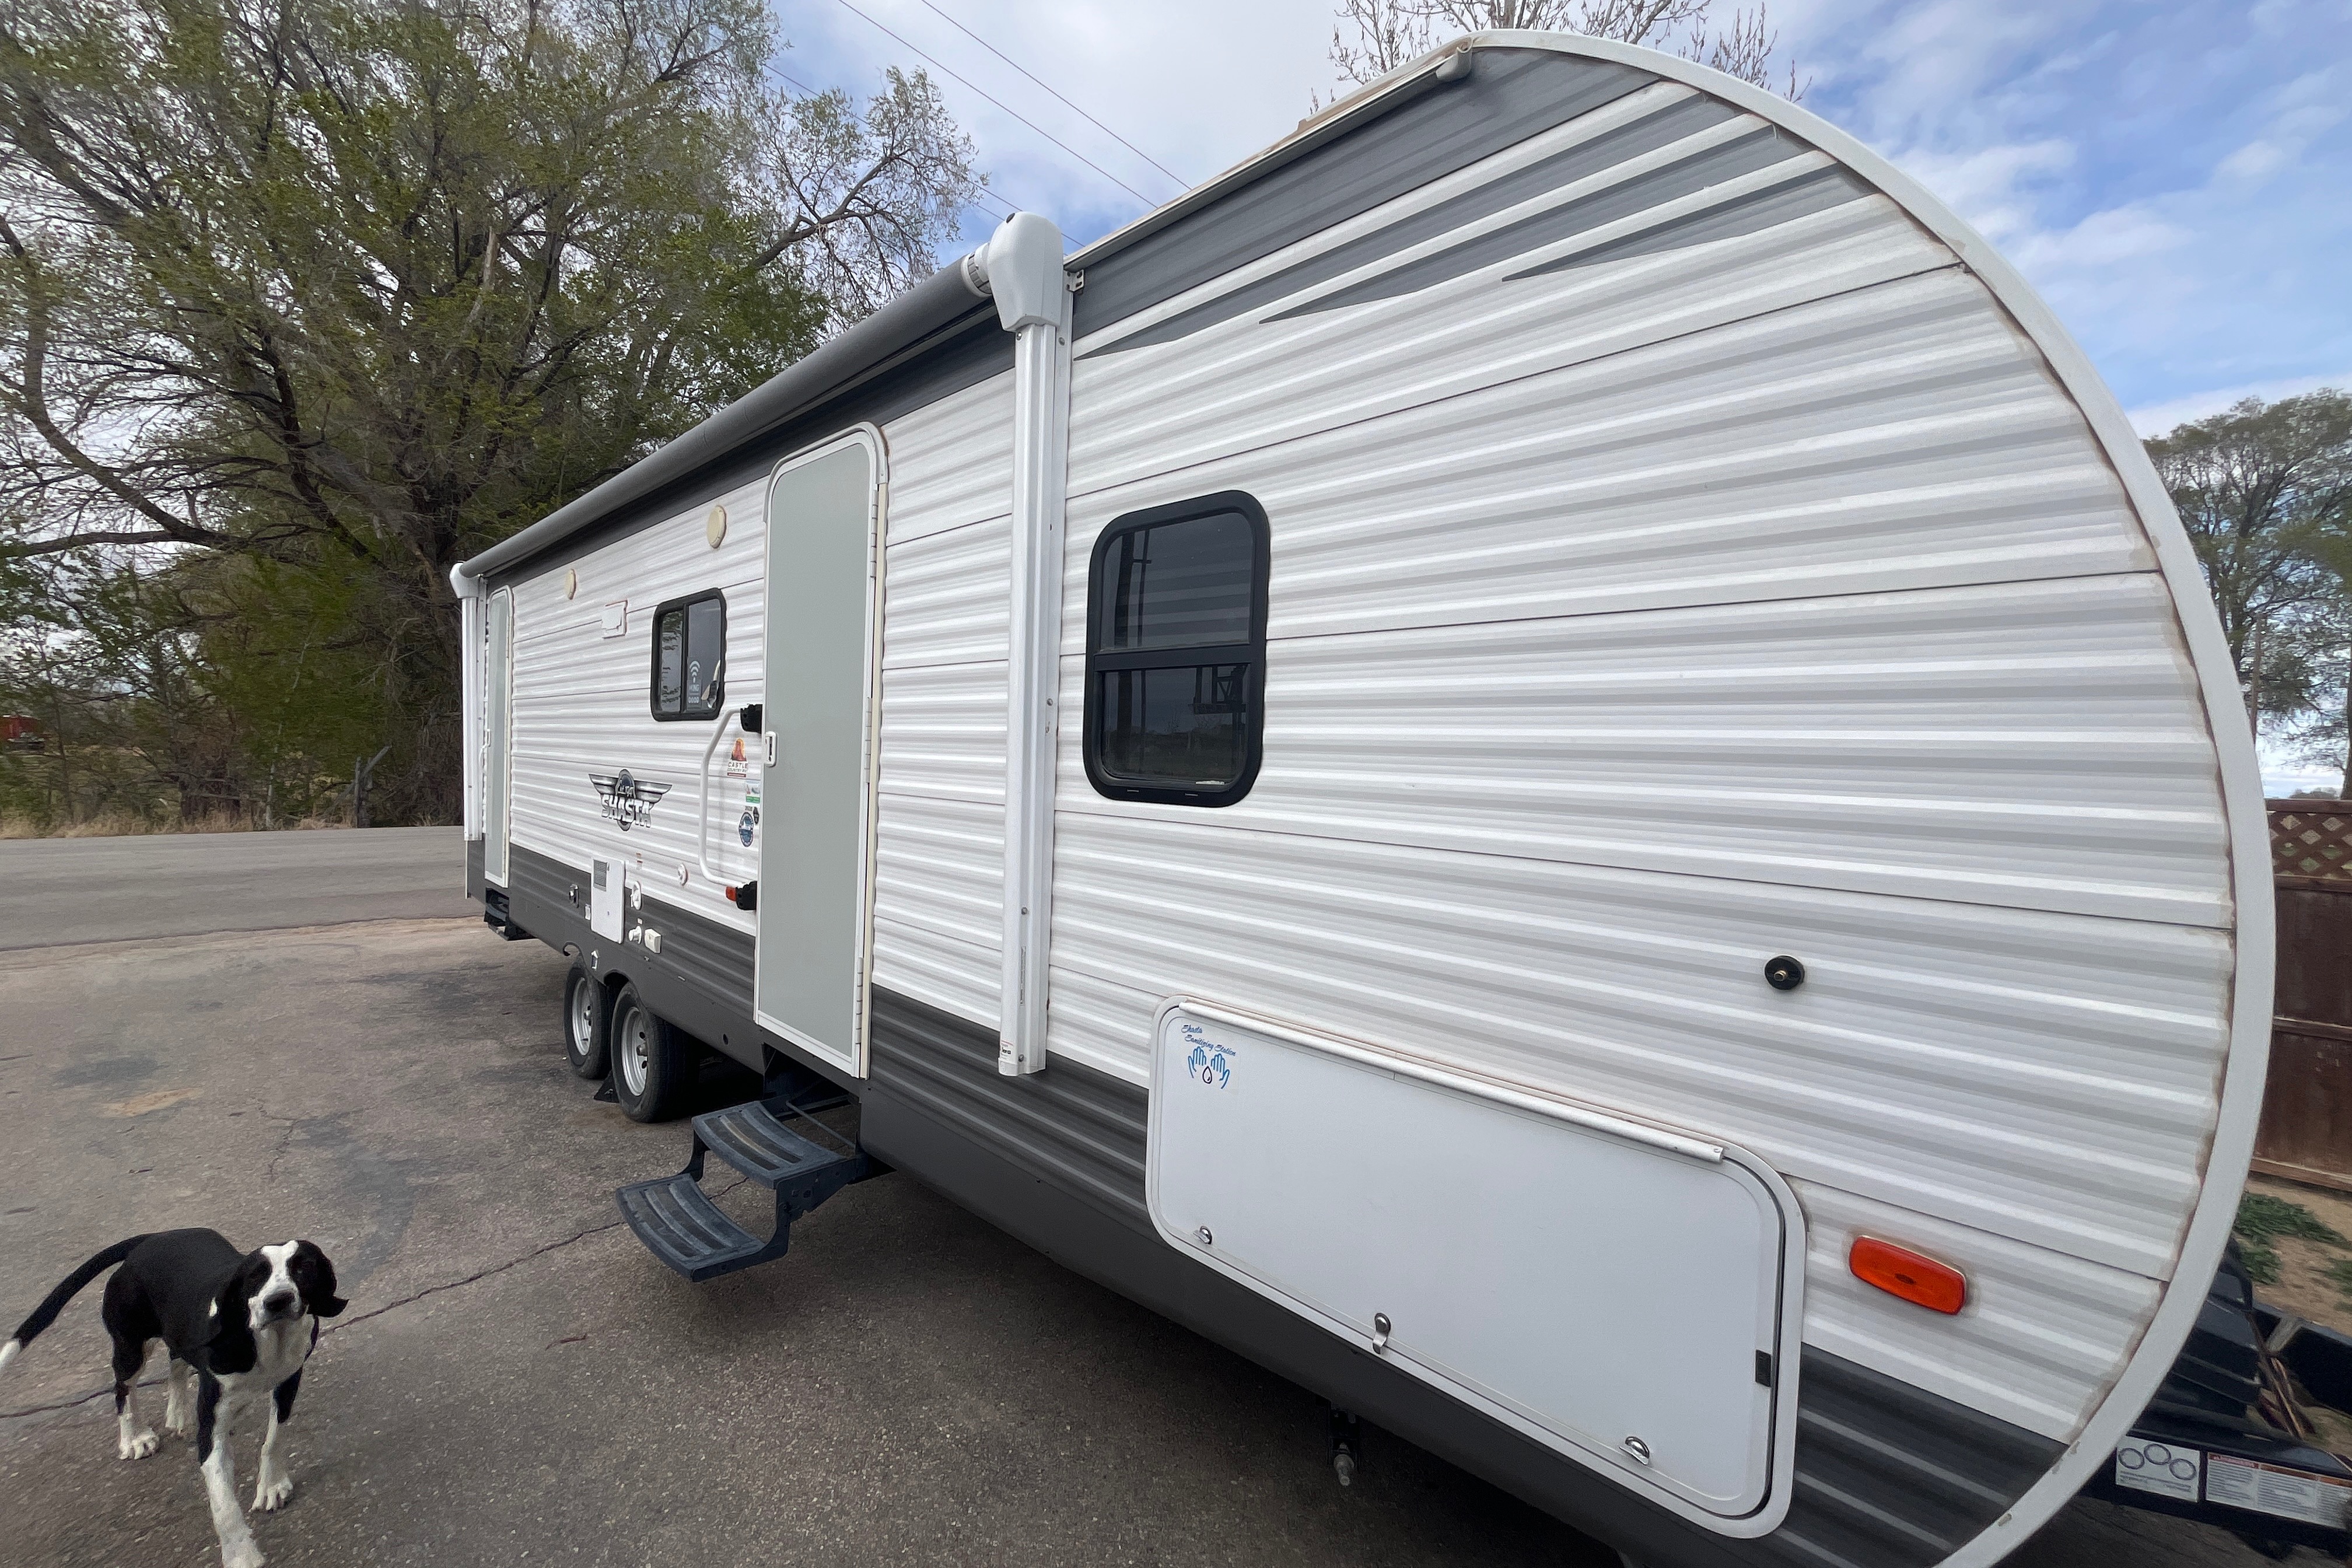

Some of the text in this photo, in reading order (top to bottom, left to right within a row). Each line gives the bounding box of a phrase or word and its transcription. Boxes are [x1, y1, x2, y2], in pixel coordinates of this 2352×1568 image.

[601, 794, 652, 828] SHASTA
[1181, 1024, 1202, 1033] Shasta
[1185, 1034, 1236, 1056] Sanitizing Station
